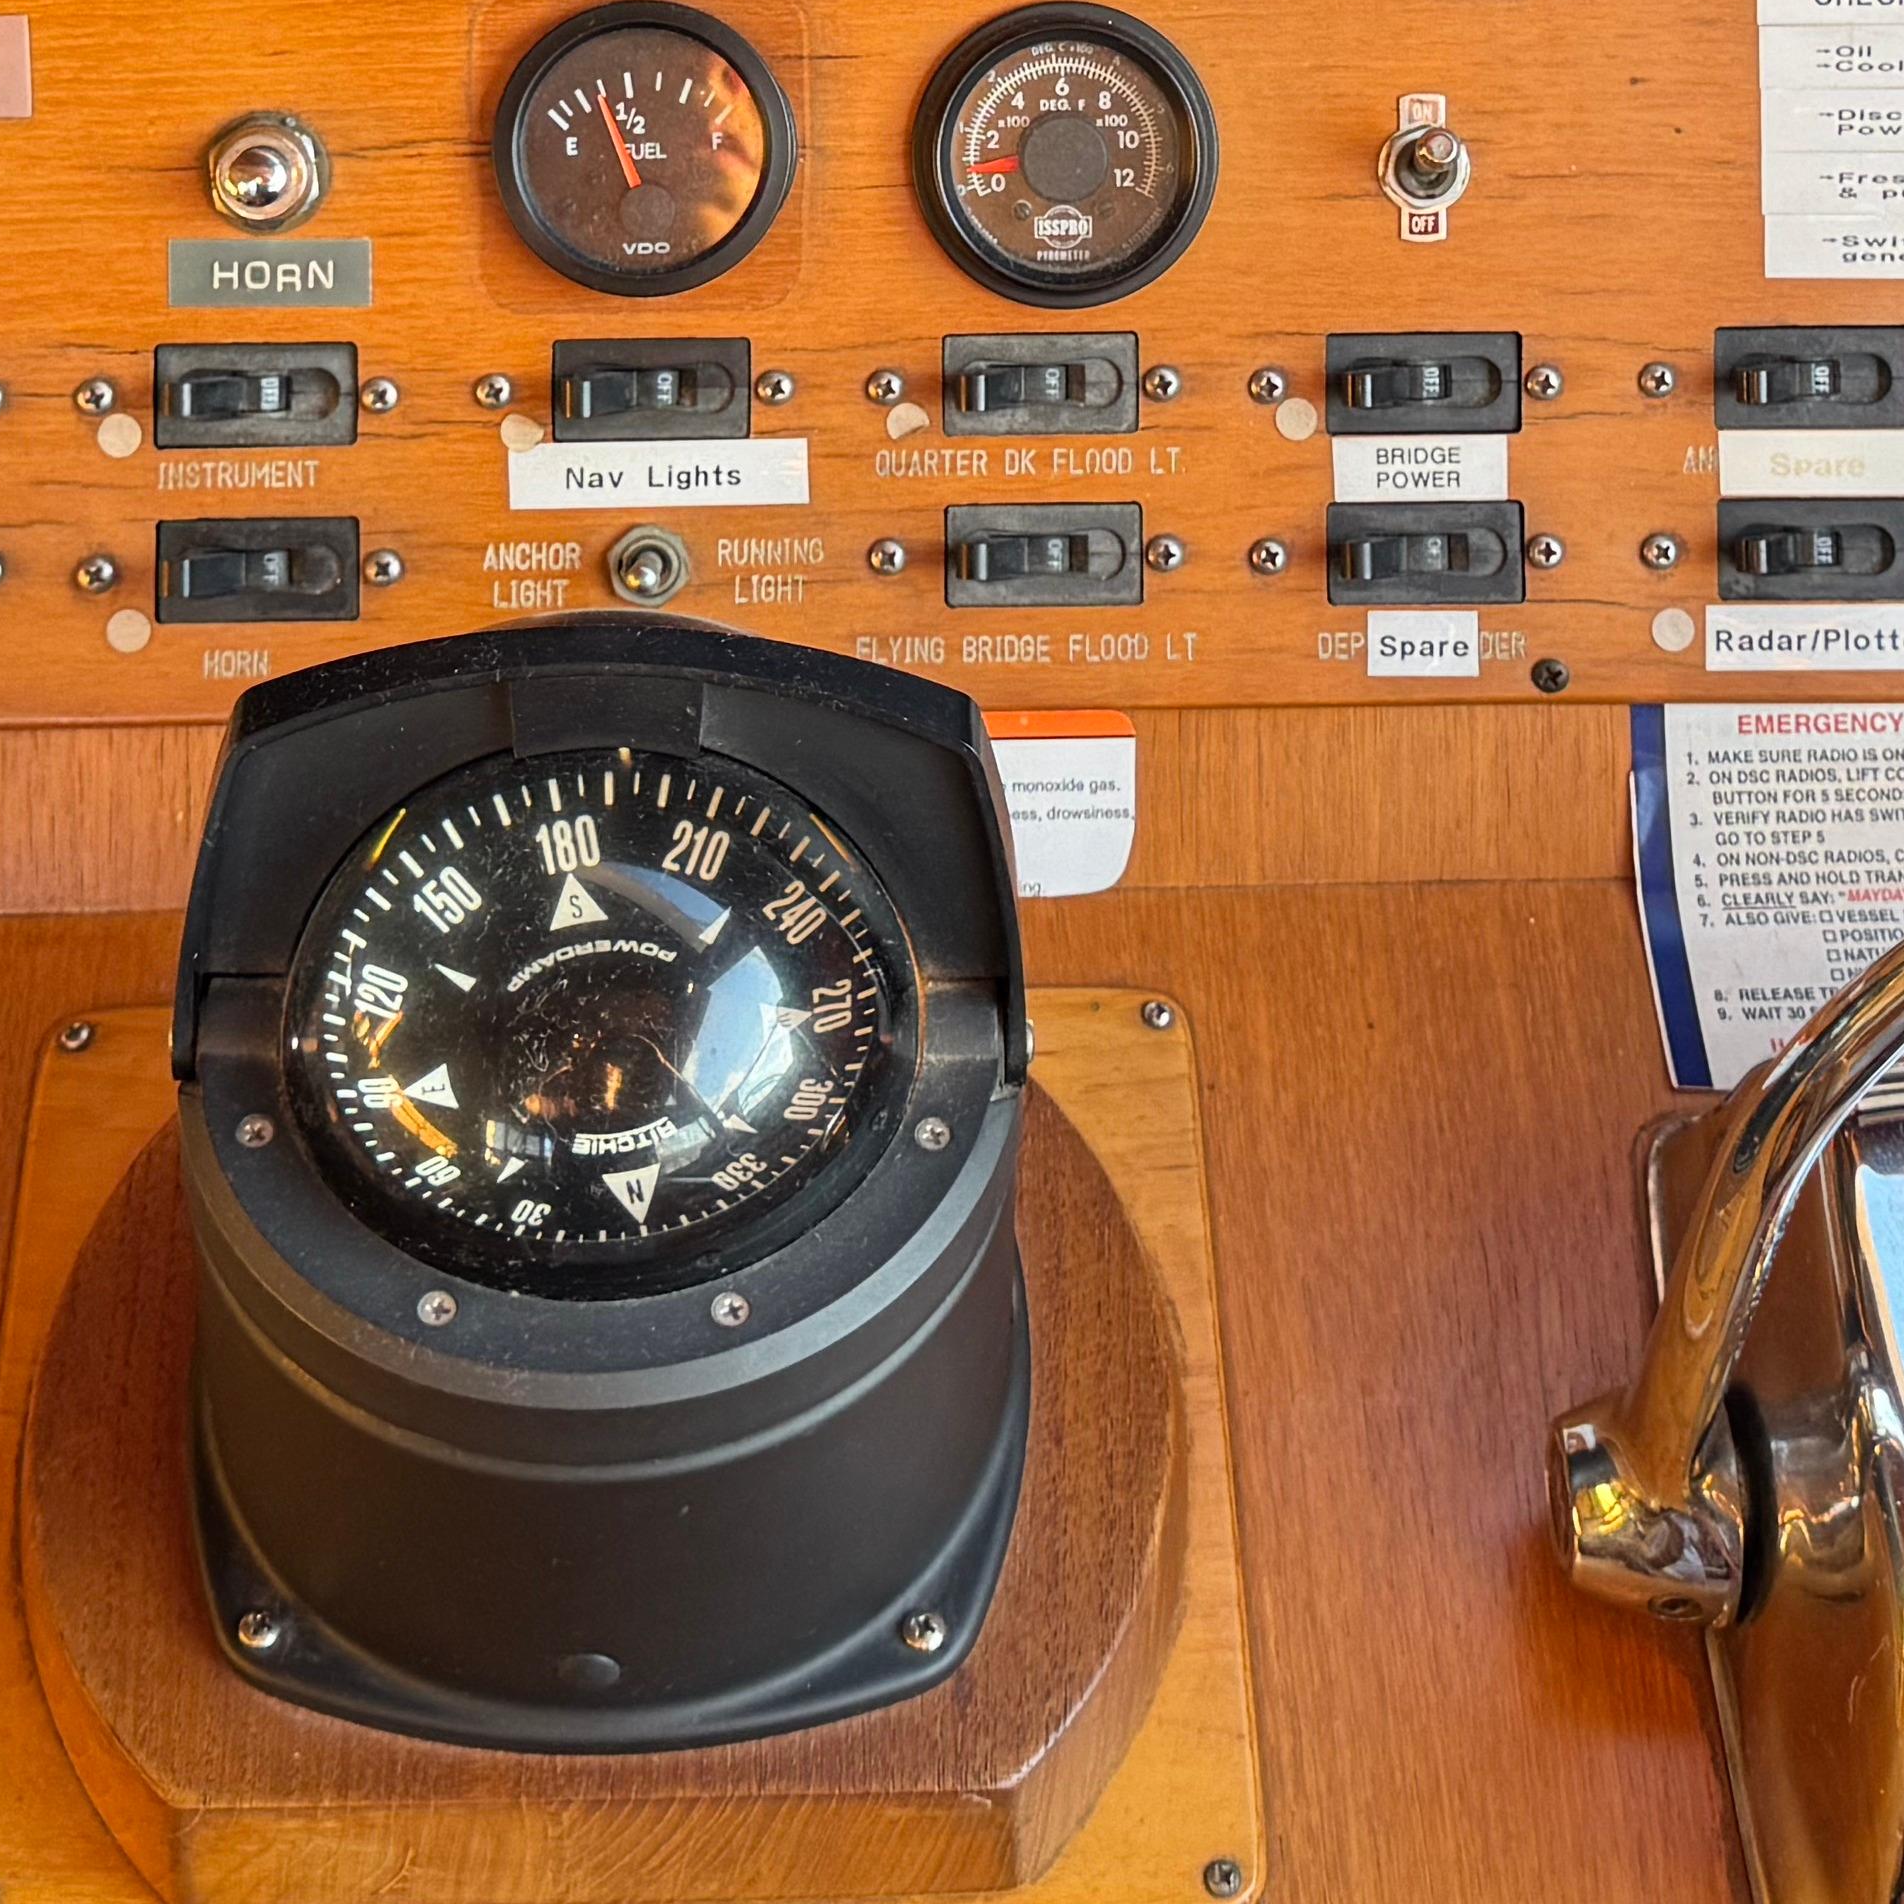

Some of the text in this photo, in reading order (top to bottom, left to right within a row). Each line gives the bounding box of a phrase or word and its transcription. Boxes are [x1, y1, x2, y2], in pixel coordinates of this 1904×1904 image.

[1836, 45, 1872, 57] Oil
[1411, 102, 1434, 122] ON
[566, 136, 578, 156] E
[712, 132, 723, 150] F
[1116, 130, 1140, 149] 10
[1114, 168, 1135, 188] 12
[1838, 187, 1857, 199] &
[1038, 216, 1089, 236] ISSPRO
[1410, 214, 1436, 234] OFF
[622, 242, 671, 255] VDO
[212, 259, 335, 293] HORN
[875, 448, 989, 479] QUARTER
[1004, 448, 1038, 477] DK
[1053, 446, 1134, 476] FLOOD
[1376, 447, 1462, 465] BRIDGE
[1770, 451, 1865, 479] Spare
[157, 460, 321, 492] INSTRUMENT
[565, 462, 743, 494] Nav Lights
[1376, 470, 1462, 489] POWER
[483, 541, 582, 573] ANCHOR
[717, 536, 826, 568] RUNNING
[492, 579, 568, 609] LIGHT
[734, 573, 809, 605] LIGHT
[856, 632, 1198, 665] FLYING BRIDGE FLOOD LT
[1379, 636, 1470, 664] Spare
[203, 649, 271, 680] HORN
[1737, 712, 1904, 735] EMERGENCY
[1686, 751, 1699, 765] 1.
[1707, 749, 1754, 765] MAKE
[1758, 748, 1802, 764] SURE
[1807, 748, 1858, 763] RADIO
[1862, 747, 1879, 763] IS
[535, 814, 602, 876] 180
[661, 820, 731, 881] 210
[413, 865, 482, 934] 150
[762, 880, 827, 946] 240
[506, 938, 678, 993] POWERDAMP
[571, 1115, 678, 1156] RITCHIE
